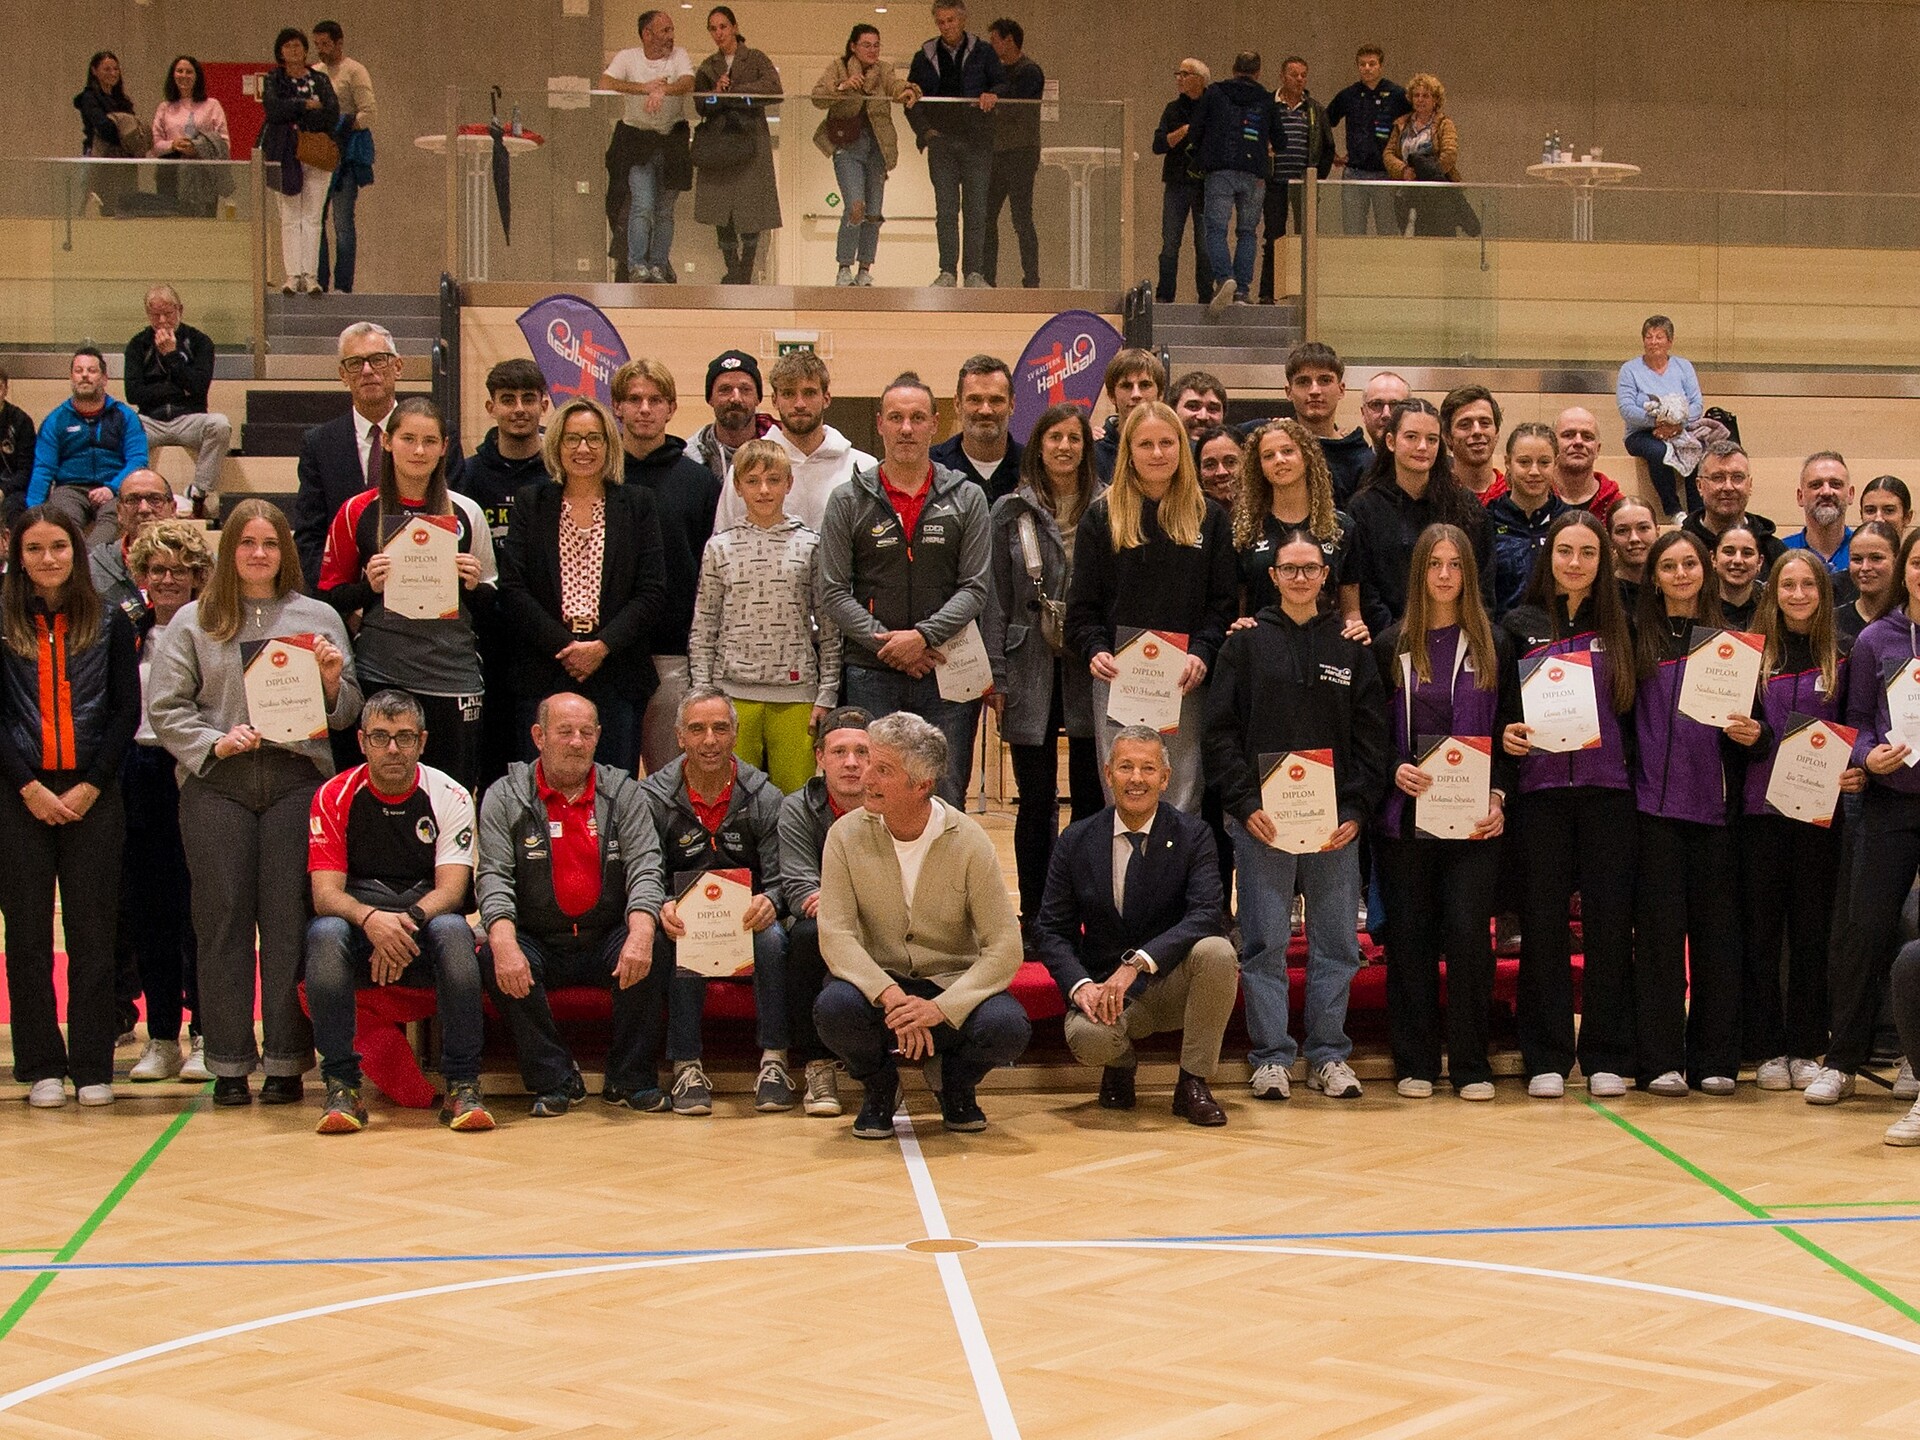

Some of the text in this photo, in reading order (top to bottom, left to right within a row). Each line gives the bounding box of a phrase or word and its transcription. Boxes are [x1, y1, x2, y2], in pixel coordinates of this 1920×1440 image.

[1037, 333, 1097, 394] Handball
[404, 555, 438, 563] DIPLOM
[1132, 667, 1165, 678] DIPLOM
[1705, 667, 1738, 678] DIPLOM
[265, 676, 300, 687] DIPLOM
[1542, 689, 1575, 700] DIPLOM
[1796, 754, 1827, 769] DIPLOM
[1437, 775, 1470, 783] DIPLOM
[1282, 790, 1315, 799] DIPLOM
[697, 910, 731, 919] DIPLOM
